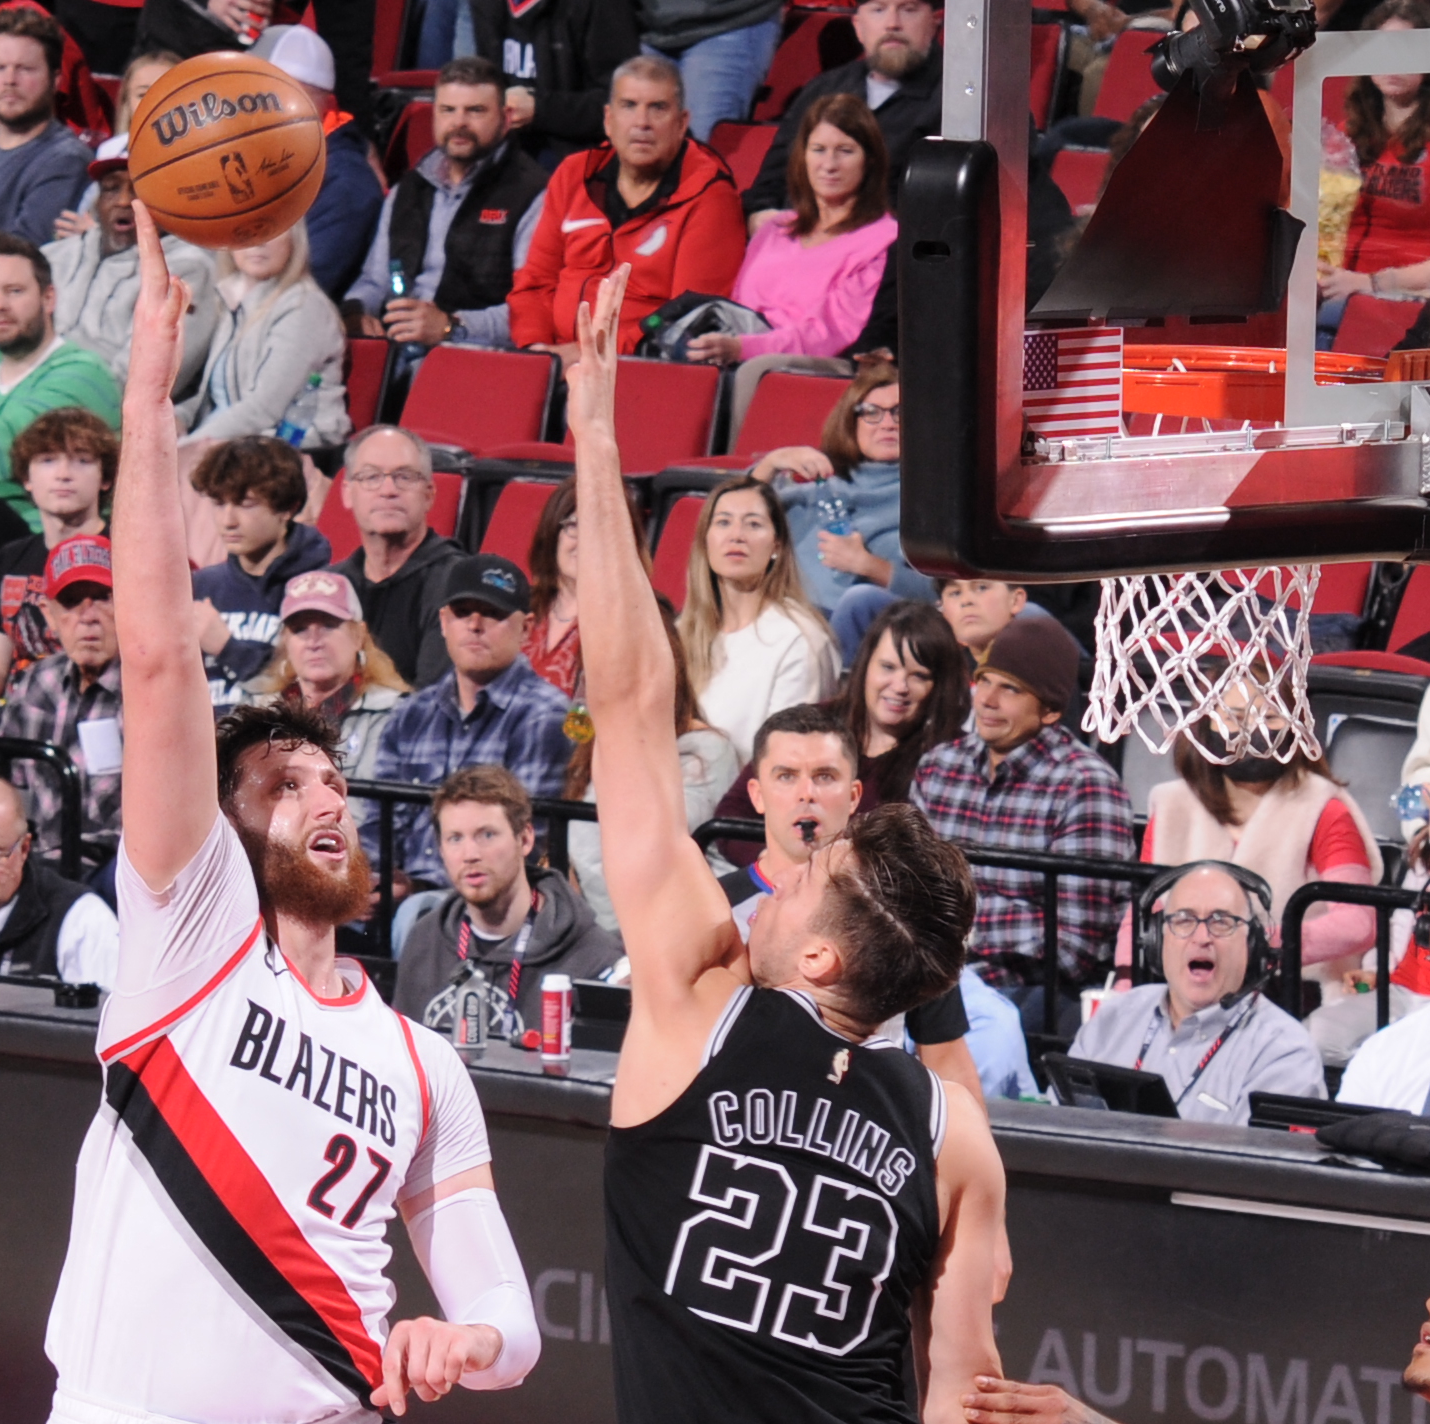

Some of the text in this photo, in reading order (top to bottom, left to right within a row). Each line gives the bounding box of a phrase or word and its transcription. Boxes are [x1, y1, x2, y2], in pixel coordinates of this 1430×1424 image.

[151, 92, 282, 147] Wilson
[229, 997, 397, 1148] BLAZERS
[306, 1132, 393, 1230] 27
[707, 1088, 916, 1197] COLLINS
[663, 1143, 899, 1357] 23
